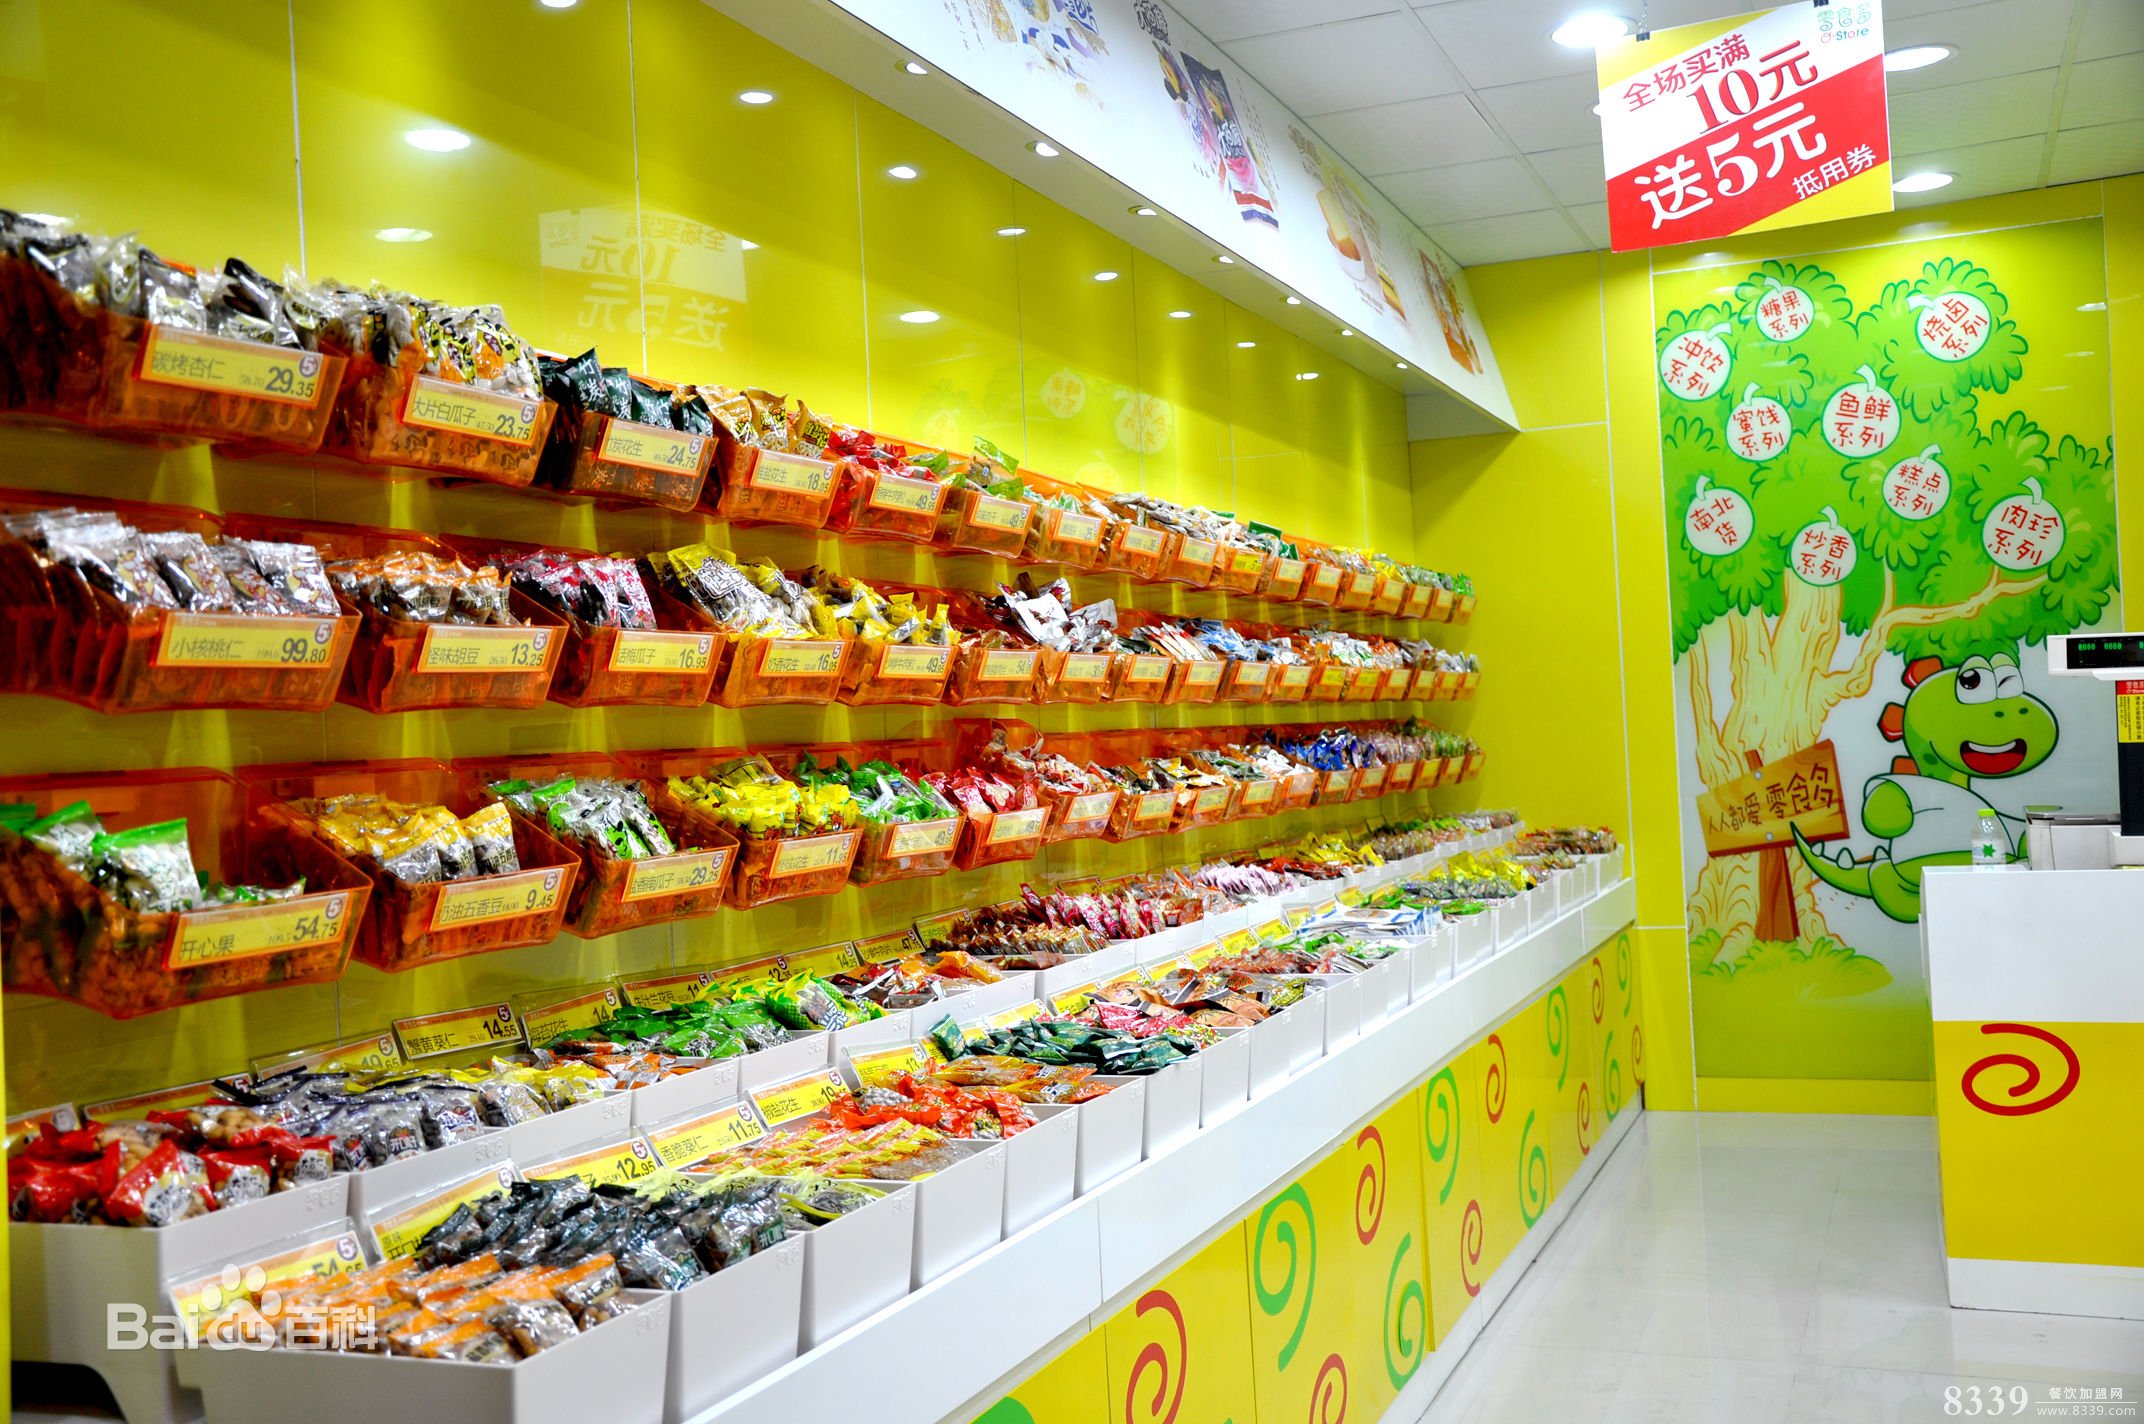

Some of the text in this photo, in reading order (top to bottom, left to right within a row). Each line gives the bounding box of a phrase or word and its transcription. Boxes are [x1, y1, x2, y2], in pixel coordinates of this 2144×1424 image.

[1623, 34, 1750, 112] 全场买满
[1687, 40, 1818, 134] 10元
[1634, 102, 1827, 229] 送5元
[1792, 144, 1876, 200] 抵用券
[1760, 289, 1800, 320] 糖果
[1769, 312, 1809, 339] 系列
[1923, 298, 1970, 343] 烧卤
[1941, 314, 1988, 359] 系列
[152, 350, 226, 381] 碳烤杏仁
[1678, 337, 1724, 373] 冲饮
[265, 366, 316, 399] 29.35
[1663, 359, 1710, 397] 系列
[412, 396, 477, 425] 大片白瓜子
[1733, 404, 1781, 434] 蜜饯
[1835, 392, 1891, 422] 鱼鲜
[493, 414, 531, 441] 23.75
[1833, 421, 1884, 449] 系列
[667, 445, 697, 469] 24.75
[1738, 431, 1785, 457] 系列
[807, 472, 829, 494] 18.05
[1899, 465, 1942, 493] 糕点
[1689, 495, 1735, 532] 南北
[1887, 485, 1933, 516] 系列
[1715, 519, 1740, 546] 货
[1999, 504, 2059, 541] 肉珍
[1803, 529, 1850, 559] 炒香
[1987, 528, 2044, 566] 系列
[1796, 553, 1841, 581] 系列
[172, 637, 245, 660] 小核桃仁
[281, 638, 327, 663] 99.80
[428, 646, 481, 665] 怪味胡豆
[511, 643, 544, 667] 13.25
[679, 649, 708, 669] 16.95
[817, 654, 838, 672] 16.05
[1709, 763, 1834, 835] 人人都爱零食多
[826, 847, 848, 866] 11.95
[689, 866, 720, 887] 29.25
[525, 889, 554, 911] 9.45
[292, 915, 338, 942] 54.75
[180, 934, 236, 961] 开心果
[483, 1018, 518, 1040] 14.55
[406, 1032, 461, 1056] 蟹黄葵仁
[728, 1119, 762, 1141] 11.75
[661, 1135, 709, 1163] 香脆葵仁
[616, 1157, 657, 1180] 12.95
